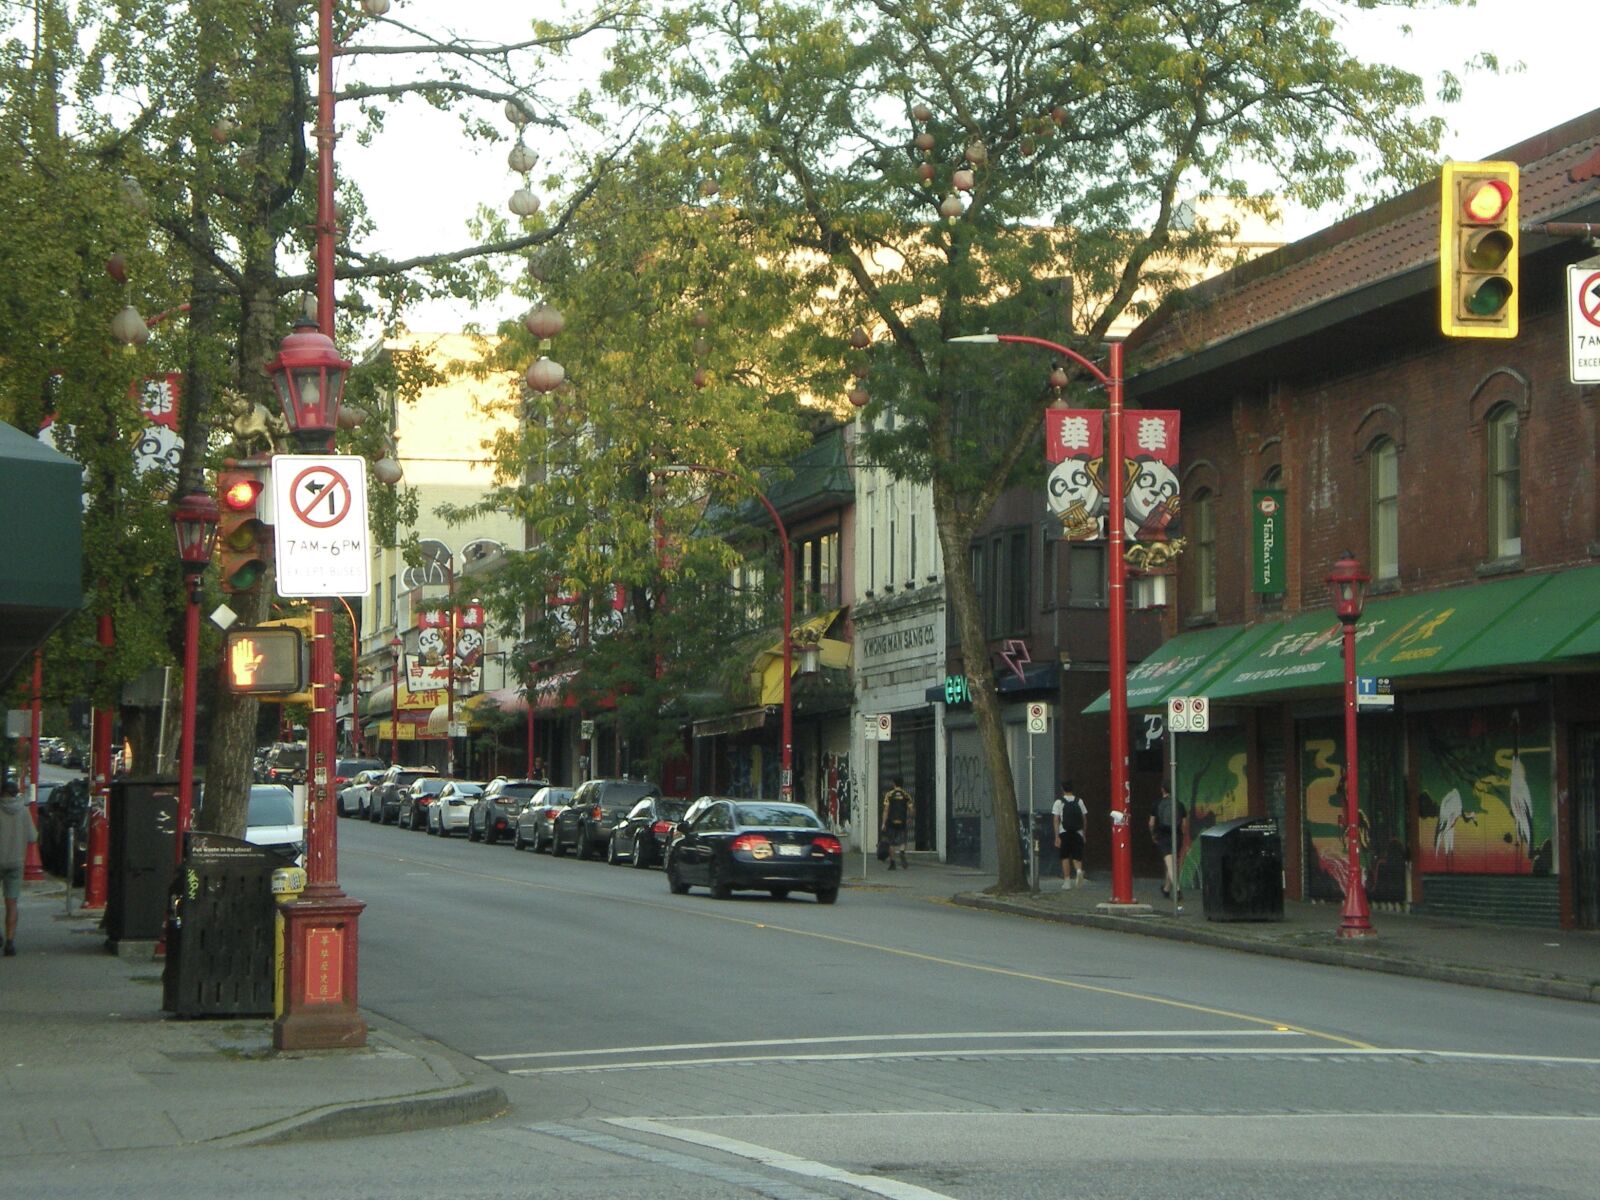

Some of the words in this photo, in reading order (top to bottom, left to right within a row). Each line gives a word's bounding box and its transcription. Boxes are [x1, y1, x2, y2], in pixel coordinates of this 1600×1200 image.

[1578, 358, 1600, 367] EXCE
[1060, 416, 1090, 449] 華
[1137, 417, 1167, 451] 華
